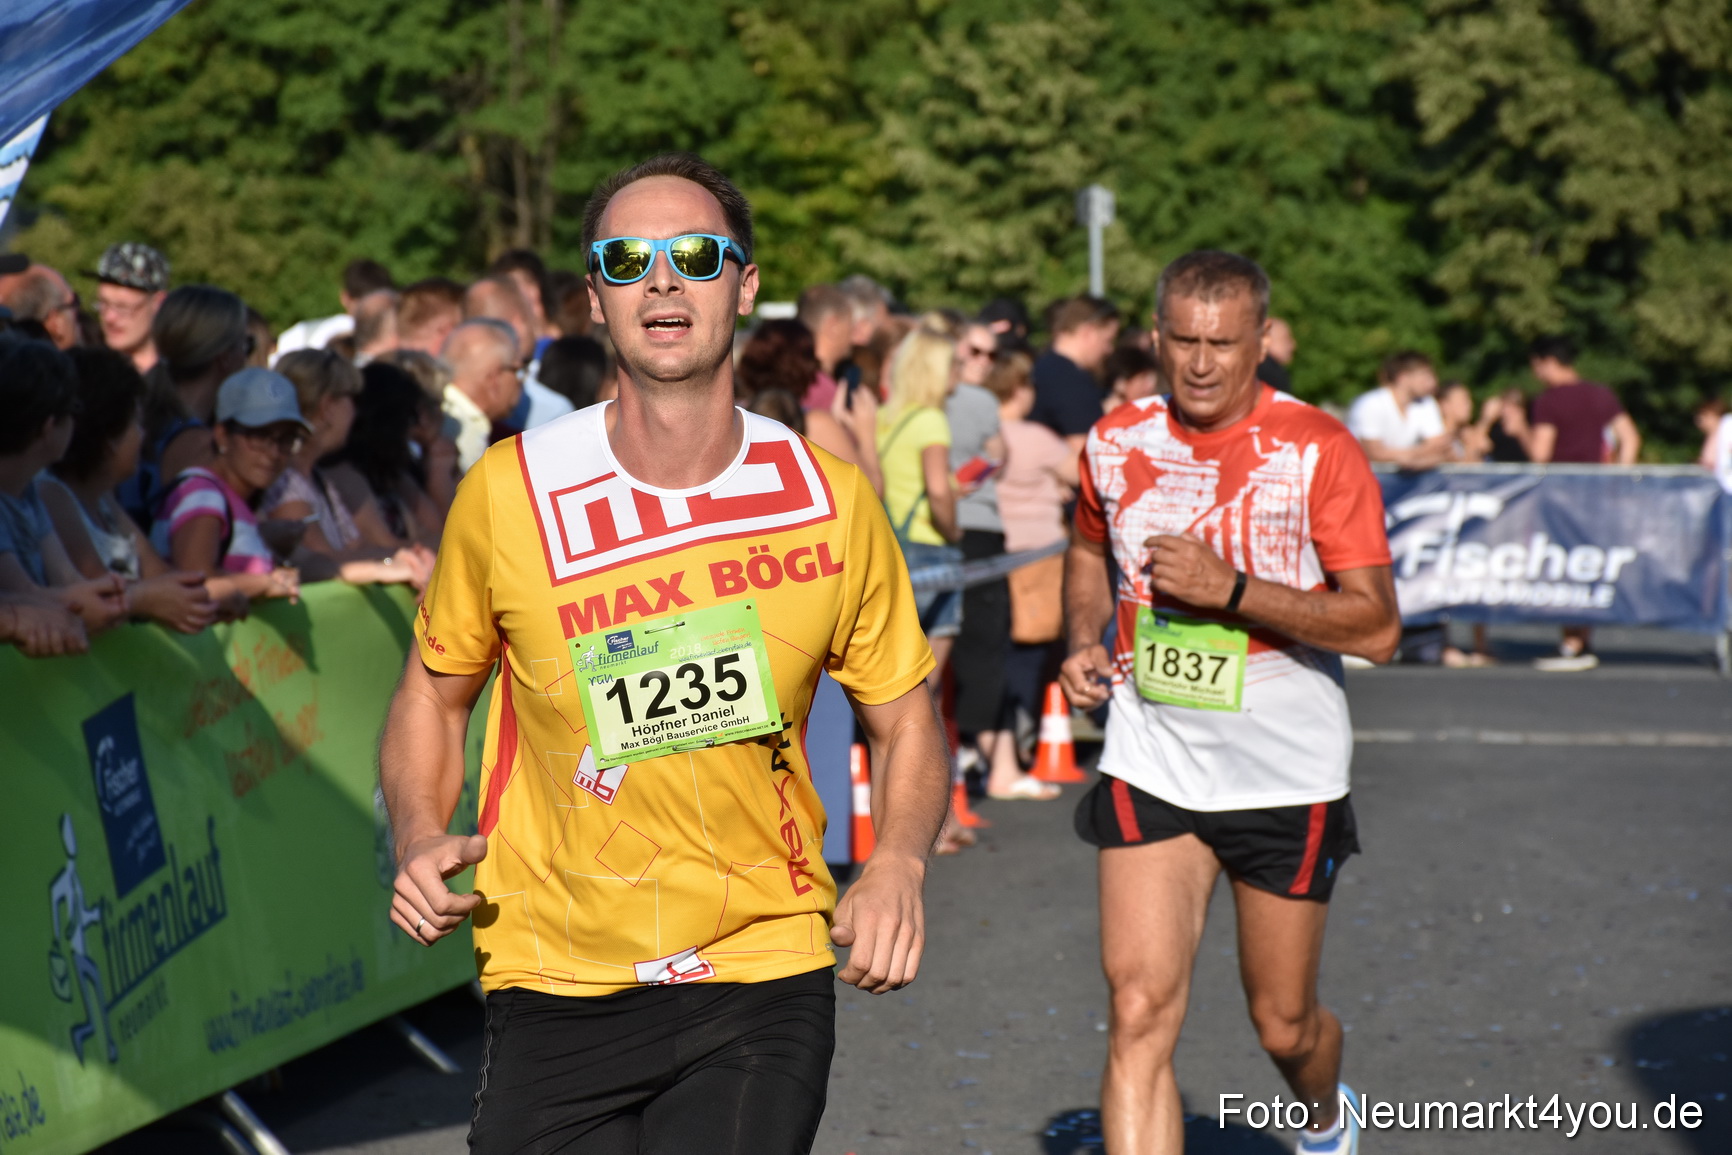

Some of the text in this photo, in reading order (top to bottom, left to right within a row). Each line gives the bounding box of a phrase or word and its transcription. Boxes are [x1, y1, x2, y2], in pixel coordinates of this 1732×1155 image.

[1401, 531, 1637, 583] Fischer
[557, 542, 844, 640] MAX BÖGL
[1424, 579, 1616, 608] AUTOMOBILE
[597, 641, 659, 666] firmenlauf
[670, 643, 702, 660] 2018
[1145, 642, 1229, 686] 1837
[606, 653, 747, 725] 1235
[621, 740, 640, 751] Max
[642, 734, 664, 747] Bögl
[667, 723, 718, 741] Bauservice
[720, 716, 750, 729] GmbH
[632, 705, 735, 738] Höpfner Daniel
[100, 815, 228, 1003] firmenlauf
